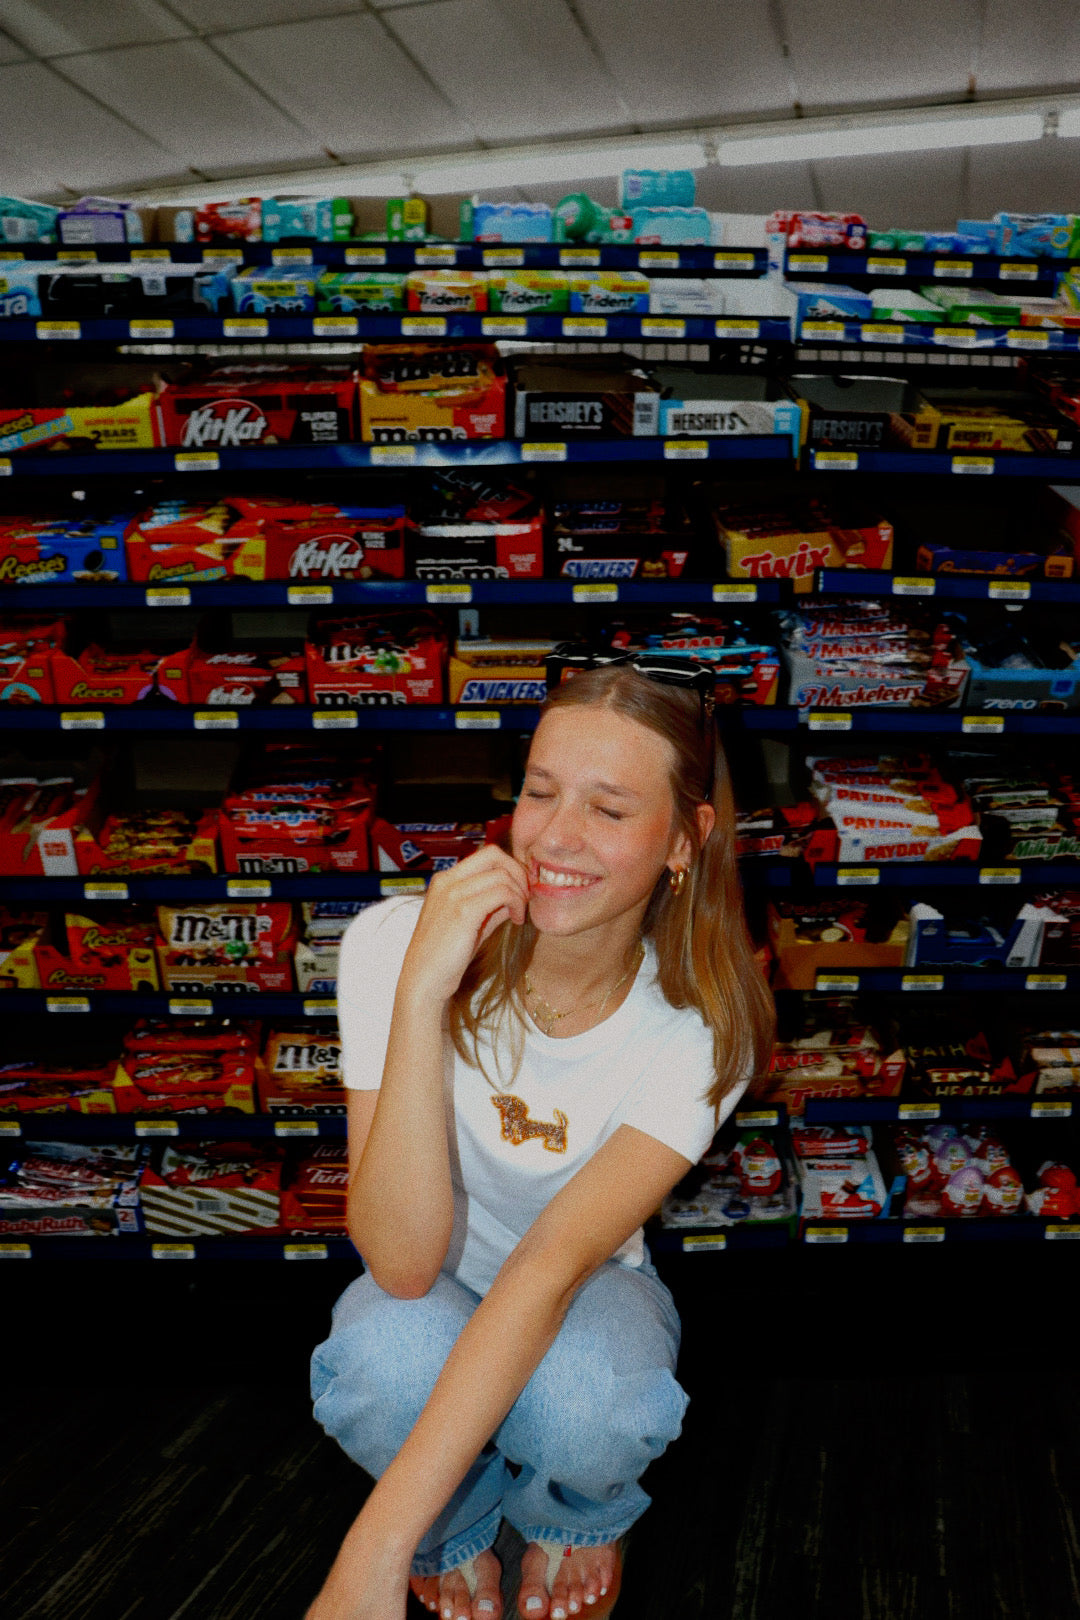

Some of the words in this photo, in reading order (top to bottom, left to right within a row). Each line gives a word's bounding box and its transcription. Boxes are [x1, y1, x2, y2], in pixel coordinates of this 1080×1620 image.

[417, 291, 471, 306] Trident
[499, 290, 551, 305] Trident
[581, 293, 634, 307] Trident
[181, 407, 267, 447] KitKat
[289, 541, 364, 577] KitKat
[739, 542, 832, 579] Twix
[565, 561, 637, 578] SNICKERS
[462, 682, 547, 701] SNICKERS
[817, 685, 922, 706] Musketeers
[864, 842, 929, 861] PAYDAY
[935, 1085, 1003, 1097] HEATH
